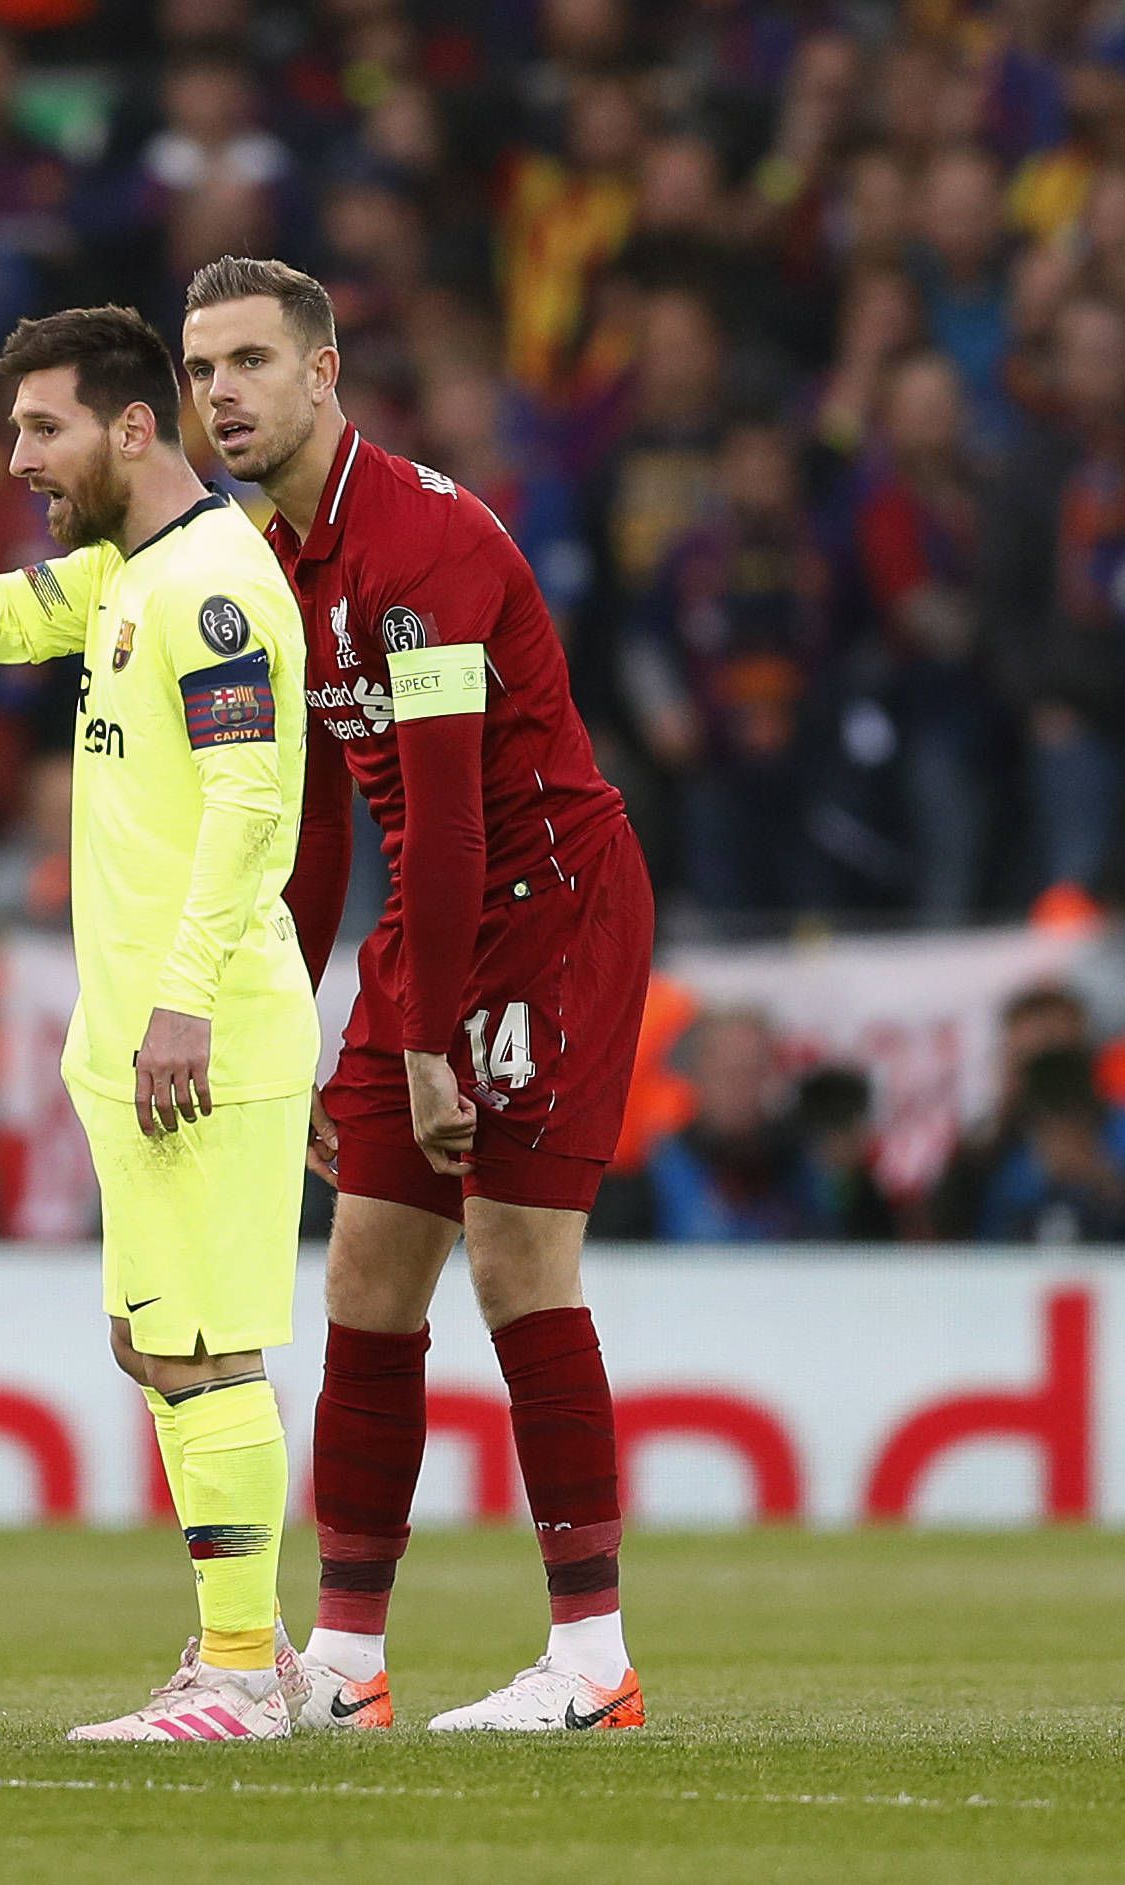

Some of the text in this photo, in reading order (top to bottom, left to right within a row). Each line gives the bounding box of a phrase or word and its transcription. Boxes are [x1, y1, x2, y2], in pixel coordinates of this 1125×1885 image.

[221, 623, 234, 641] 5
[392, 675, 441, 694] ESPECT
[464, 1001, 536, 1089] 14
